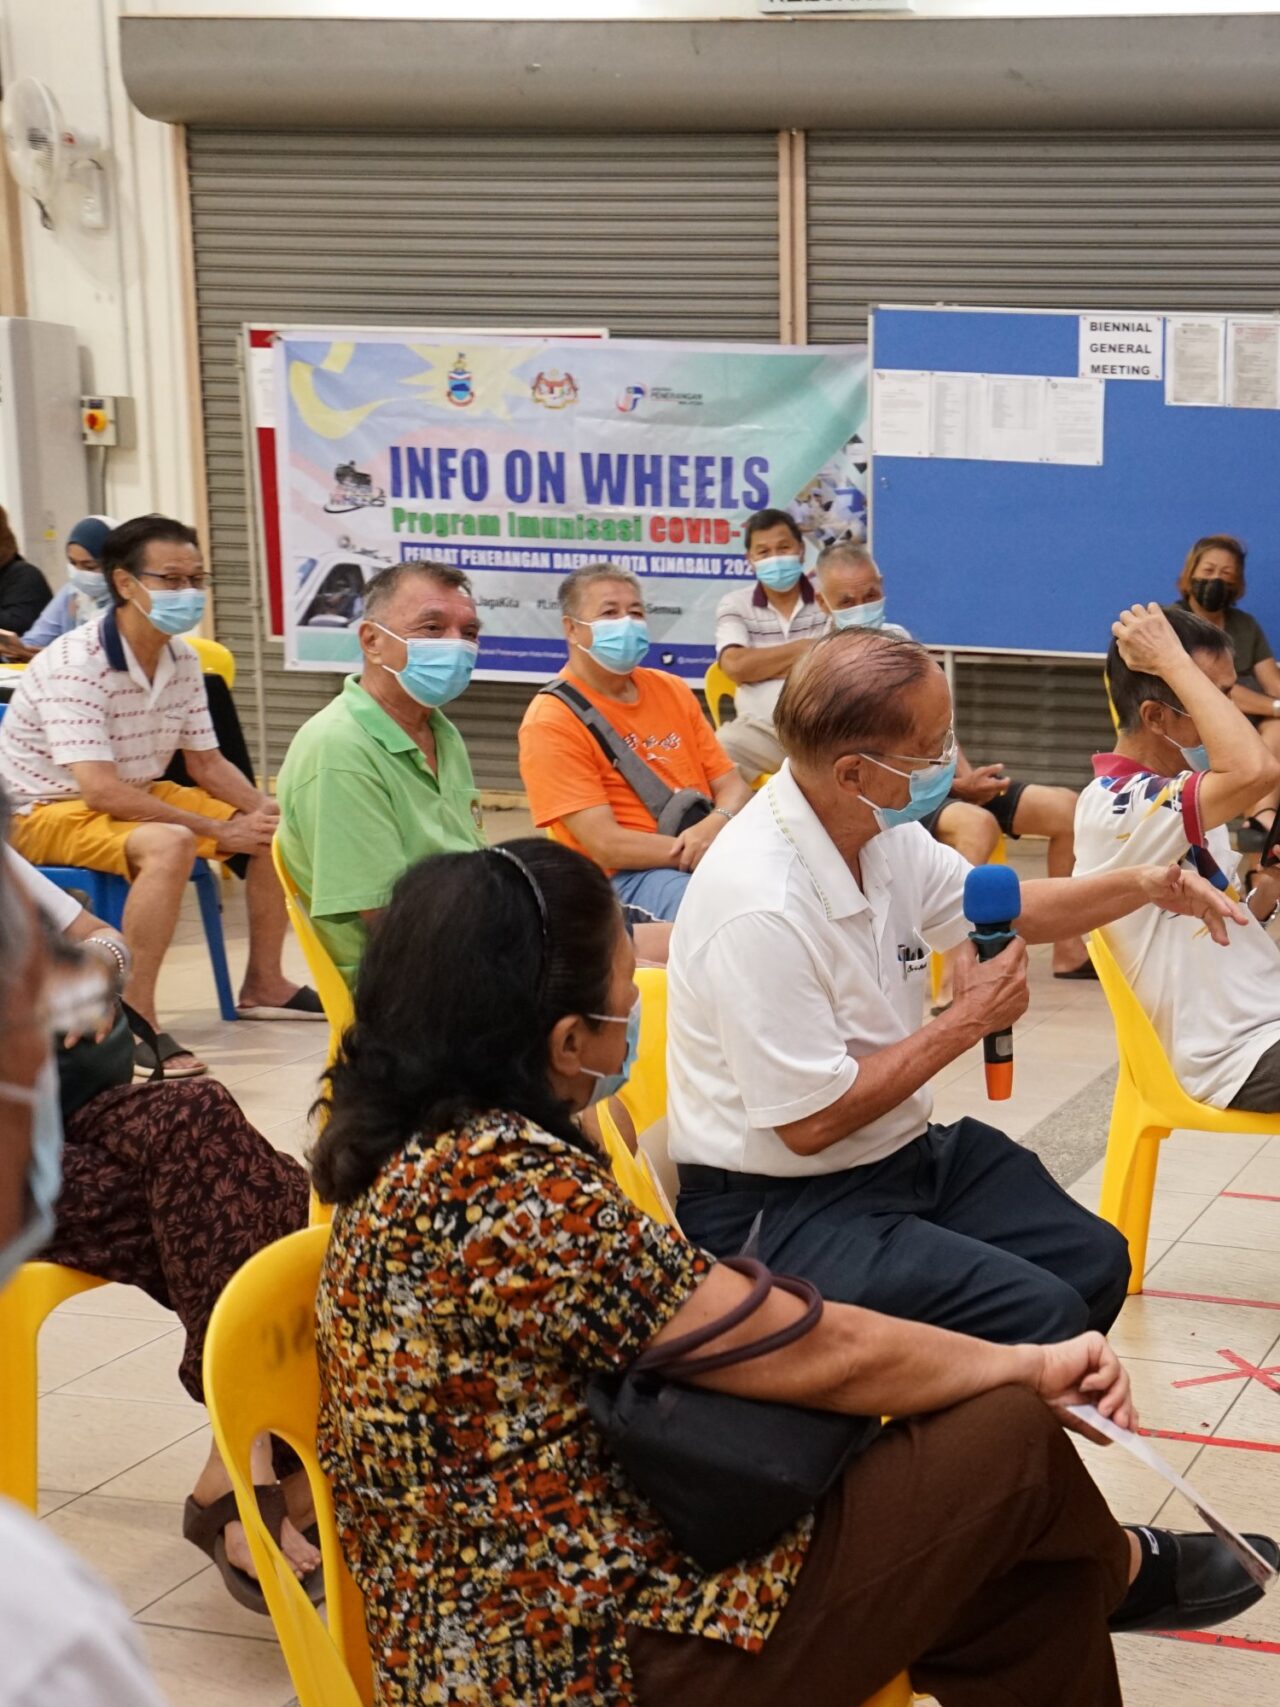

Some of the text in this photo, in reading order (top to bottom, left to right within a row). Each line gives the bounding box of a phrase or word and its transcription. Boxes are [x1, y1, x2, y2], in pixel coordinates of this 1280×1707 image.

[1089, 321, 1153, 333] BIENNIAL
[1089, 343, 1152, 354] GENERAL
[1090, 364, 1151, 376] MEETING
[389, 446, 770, 511] INFO ON WHEELS
[392, 507, 747, 545] Program Imunisasi COVID-
[403, 547, 458, 567] PEJABAT
[461, 549, 551, 569] PENERANGAN
[611, 555, 649, 575] KOTA
[651, 556, 721, 575] KINABALU
[724, 558, 754, 576] 202
[476, 596, 520, 611] JagaKita
